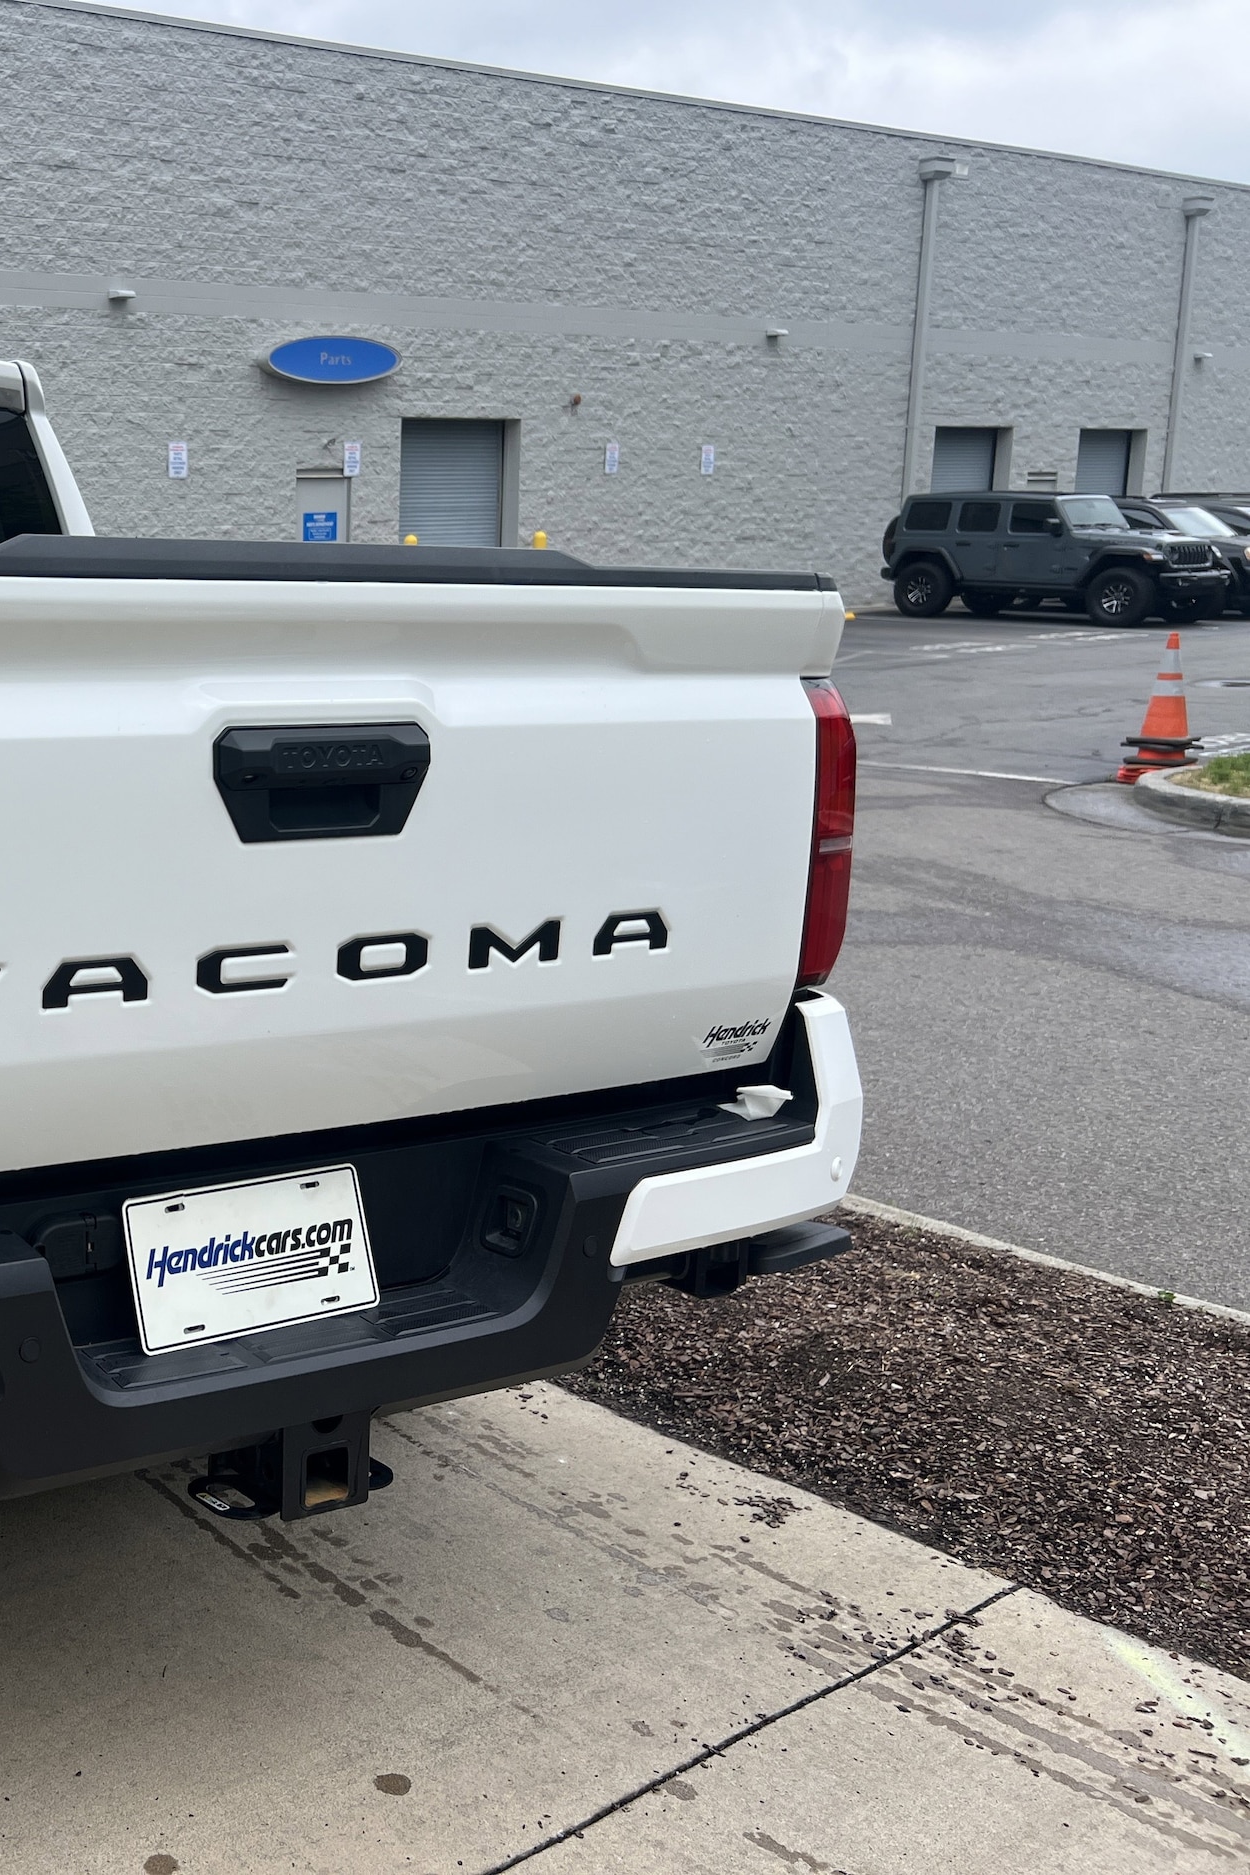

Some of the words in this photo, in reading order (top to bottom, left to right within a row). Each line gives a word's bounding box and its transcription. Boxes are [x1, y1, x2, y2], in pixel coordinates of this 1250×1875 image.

[320, 352, 351, 365] Parts
[281, 744, 384, 769] TOYOTA
[702, 1018, 771, 1048] Hendrick
[145, 1218, 353, 1288] Hendrickcars.com
